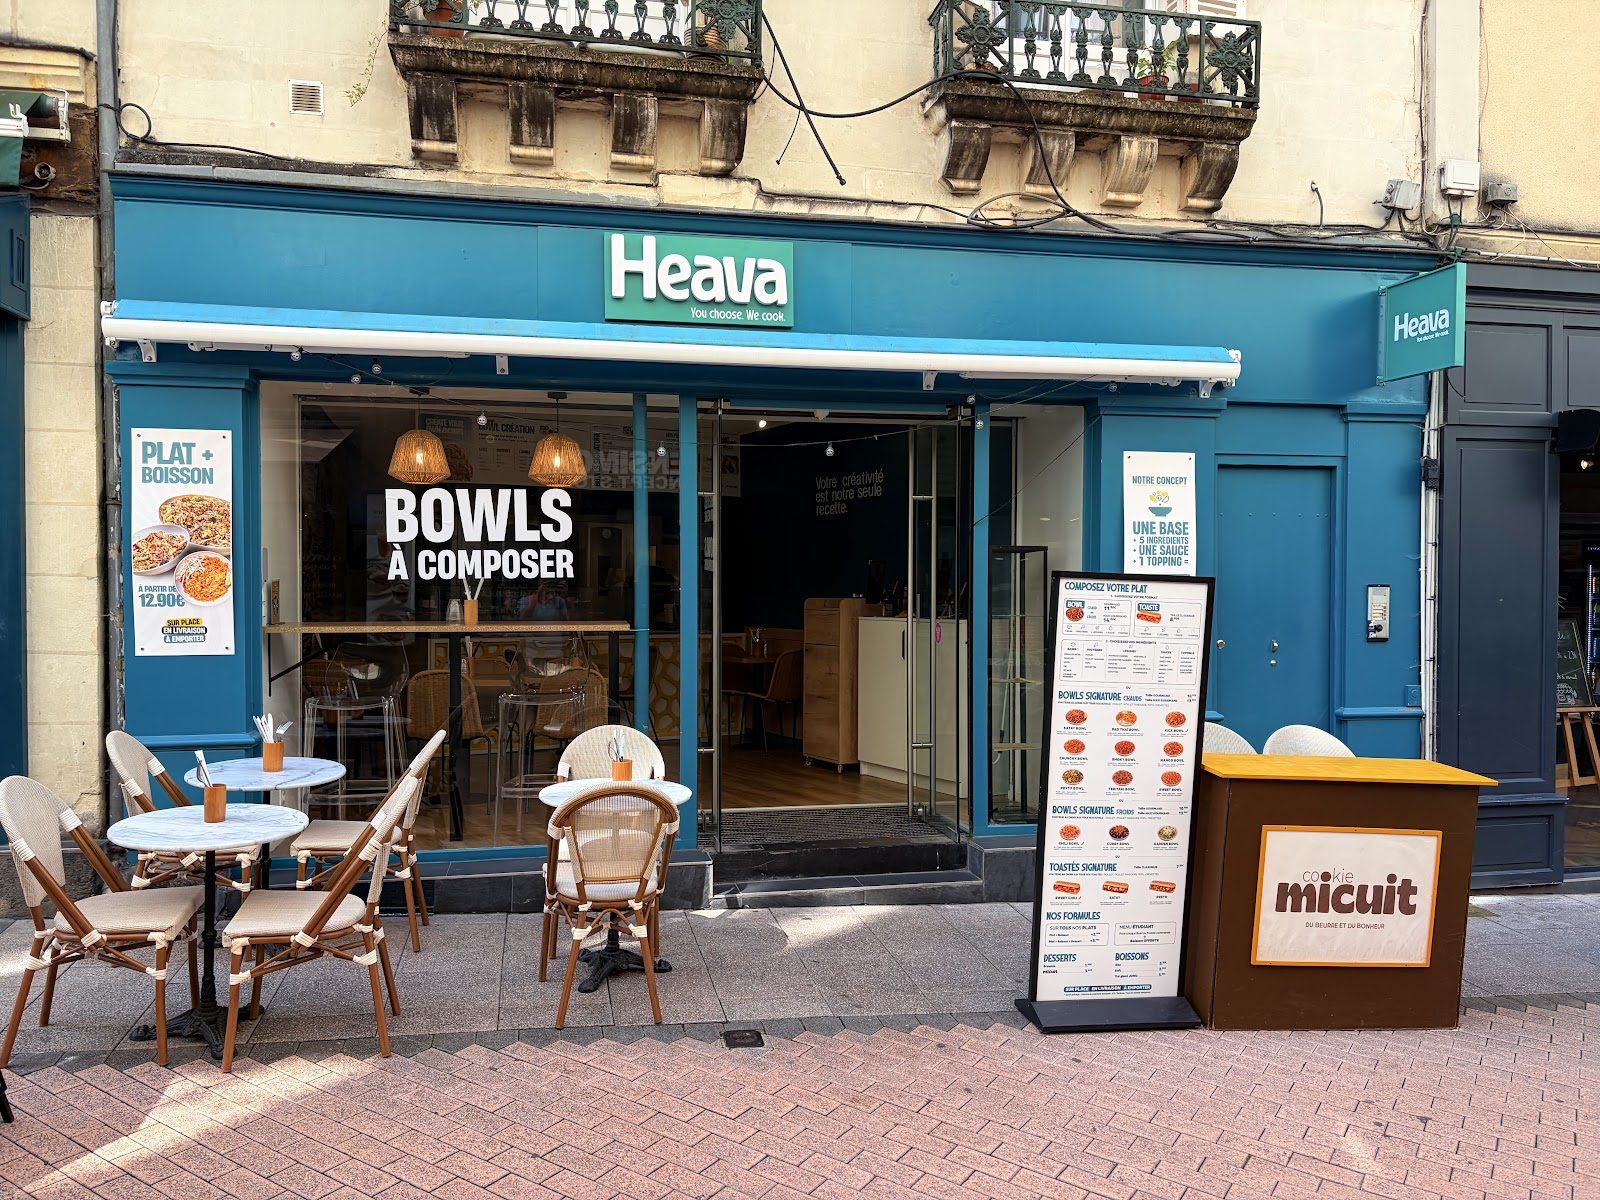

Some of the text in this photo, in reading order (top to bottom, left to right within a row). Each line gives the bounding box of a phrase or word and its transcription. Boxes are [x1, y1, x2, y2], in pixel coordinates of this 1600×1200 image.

[611, 233, 787, 305] Heava
[691, 307, 785, 322] You choose. We cook.
[1394, 309, 1449, 341] Heava
[501, 423, 535, 434] CRÉATION
[141, 441, 196, 465] PLAT
[141, 466, 214, 484] BOISSON
[816, 468, 884, 490] Votre créativité
[1132, 476, 1187, 485] NOTRE CONCEPT
[816, 483, 882, 502] est notre seule
[816, 502, 848, 516] recette.
[385, 488, 573, 543] BOWLS
[1132, 521, 1189, 535] UNE BASE
[1139, 536, 1189, 545] 5 INGREDIENTS
[1139, 545, 1189, 556] UNE SAUCE
[387, 544, 575, 580] À COMPOSER
[1147, 556, 1182, 566] TOPPING
[138, 584, 143, 592] À
[1064, 581, 1148, 593] COMPOSEZ VOTRE PLAT
[138, 593, 185, 607] 12.90€
[1067, 600, 1084, 608] BOWL
[181, 618, 200, 626] PLACE
[173, 626, 206, 634] LIVRAISON
[1058, 690, 1084, 700] BOWLS
[1085, 691, 1122, 701] SIGNATURE
[1052, 805, 1078, 814] BOWLS
[1079, 806, 1115, 815] SIGNATURE
[1049, 861, 1117, 872] TOASTÉS SIGNATURE
[1302, 868, 1354, 883] cookie
[1275, 873, 1418, 915] micuit
[1046, 911, 1101, 920] NOS FORMULES
[1043, 952, 1149, 963] DESSERTS BOISSONS
